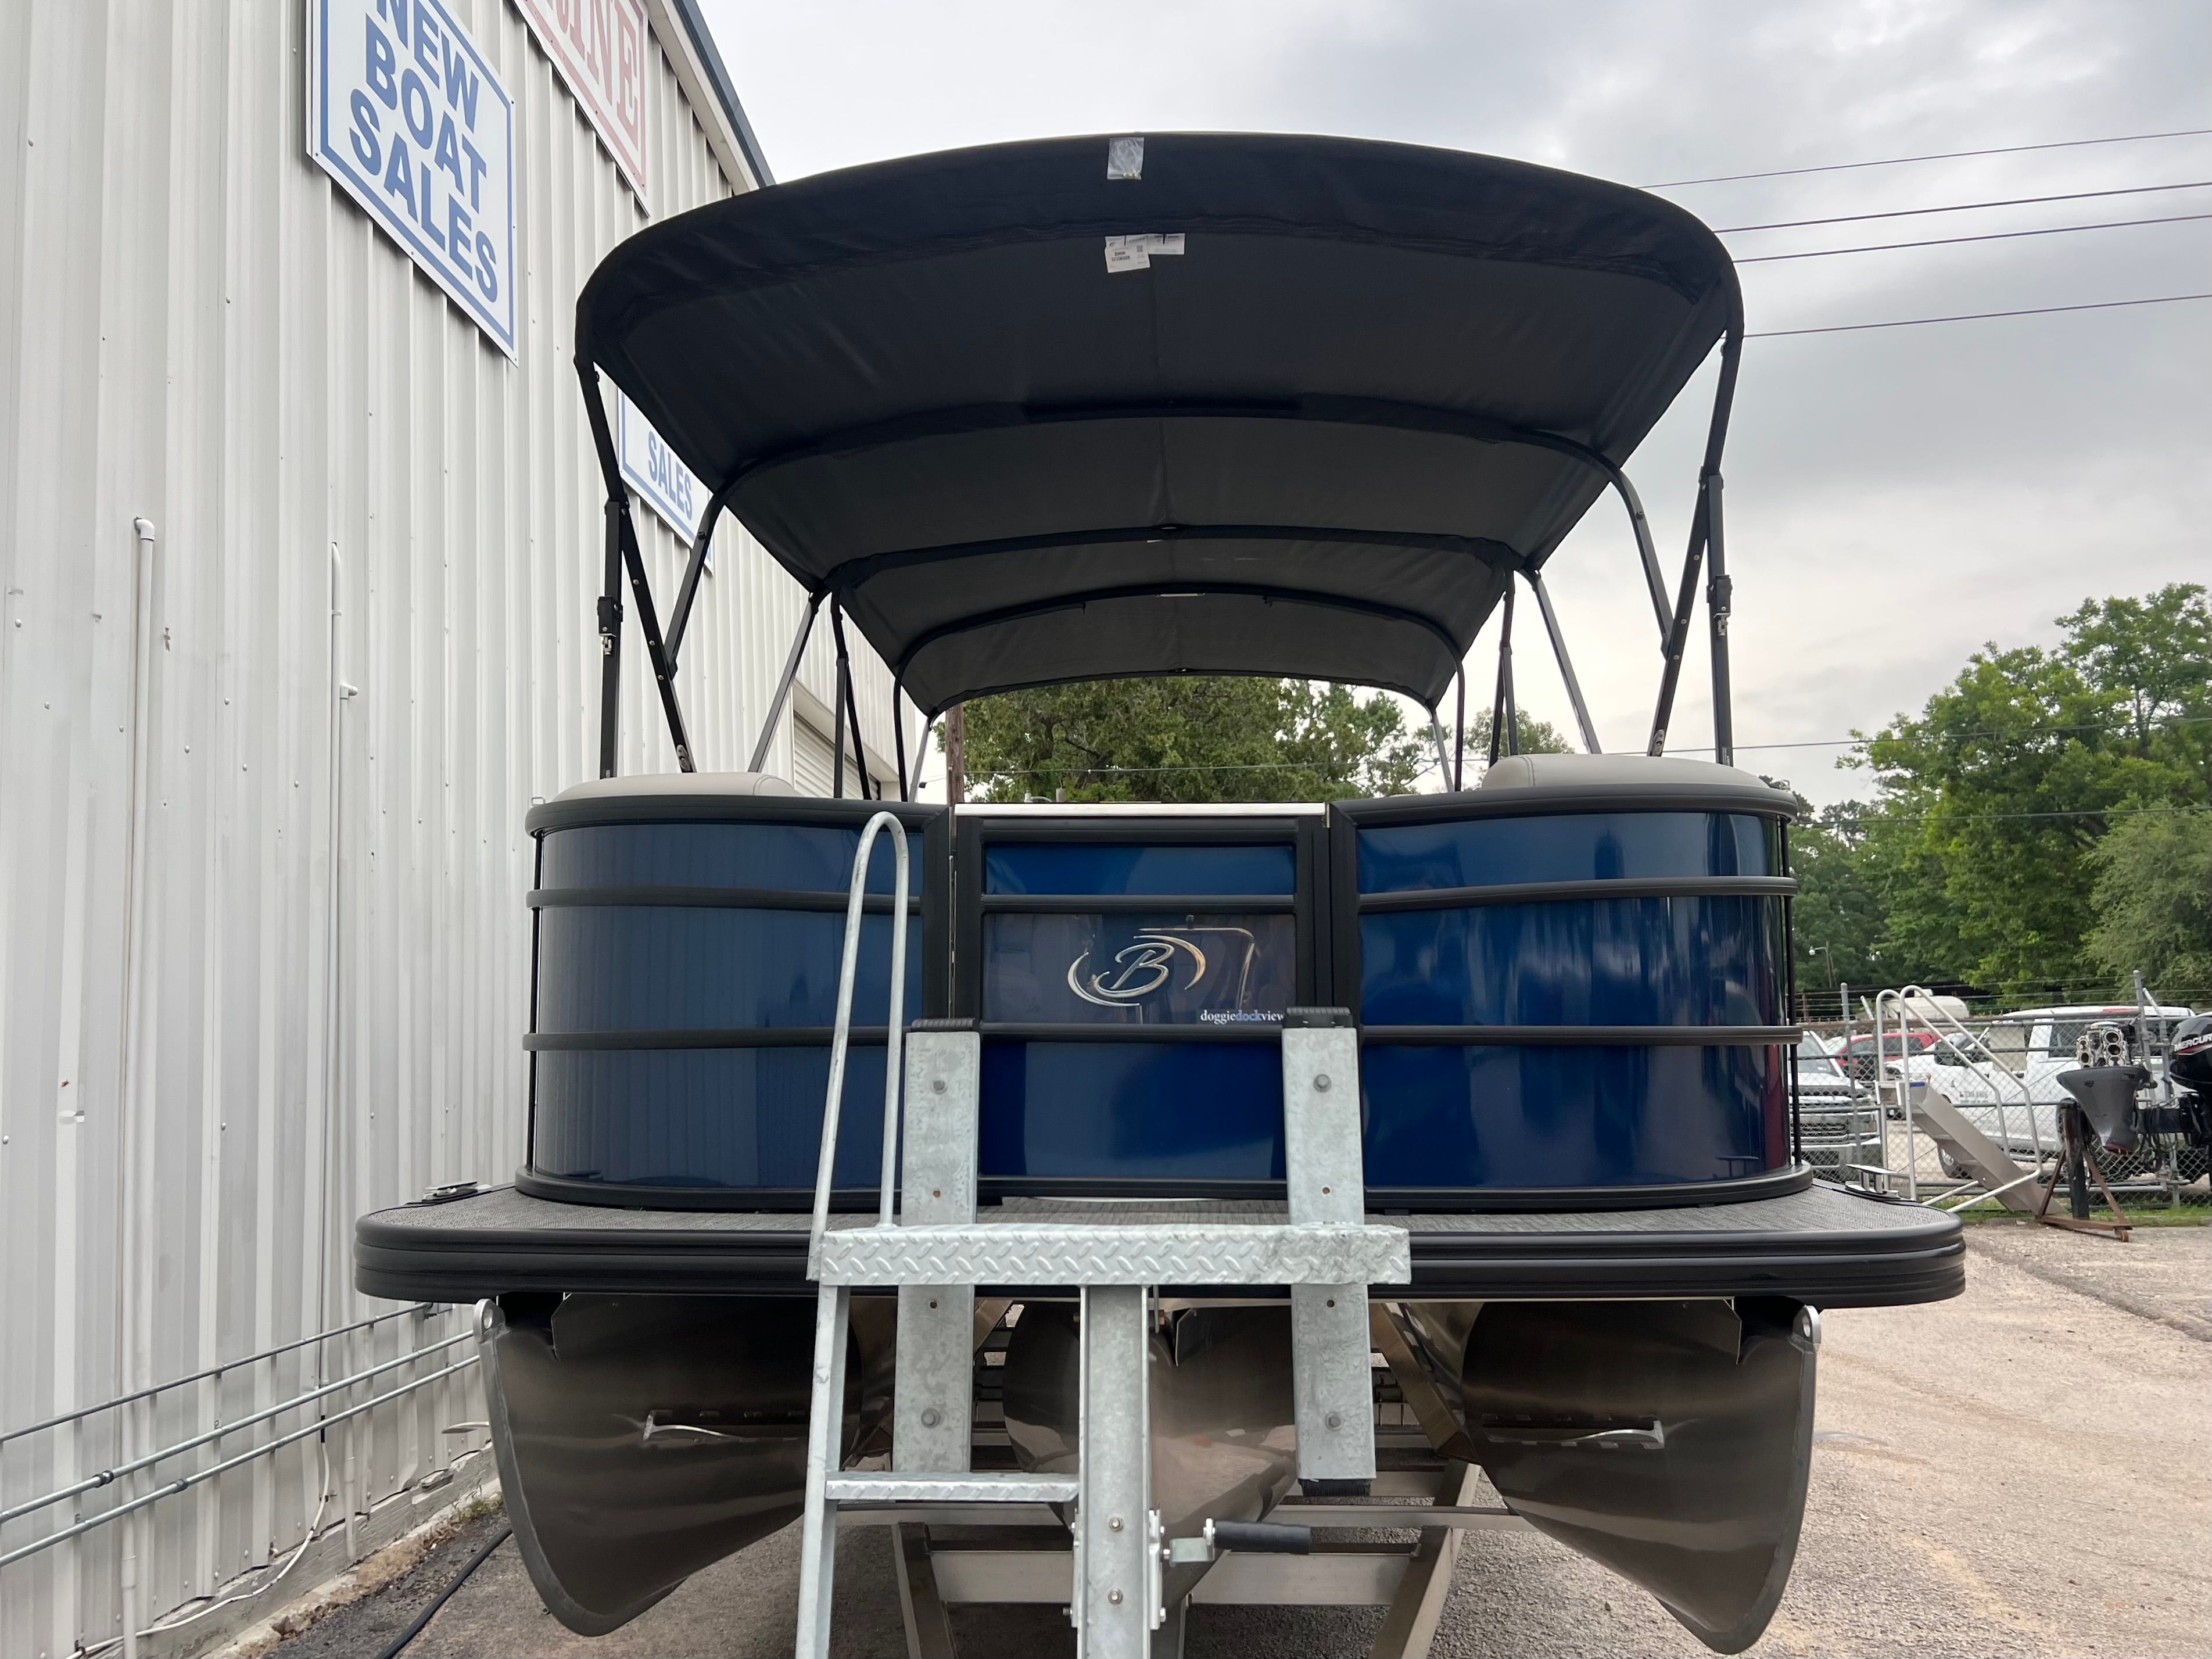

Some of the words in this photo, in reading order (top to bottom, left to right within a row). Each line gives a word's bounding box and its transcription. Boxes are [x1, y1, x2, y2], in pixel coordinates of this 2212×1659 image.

[349, 88, 497, 303] SALES
[365, 13, 487, 214] BOAT
[648, 431, 693, 521] SALES
